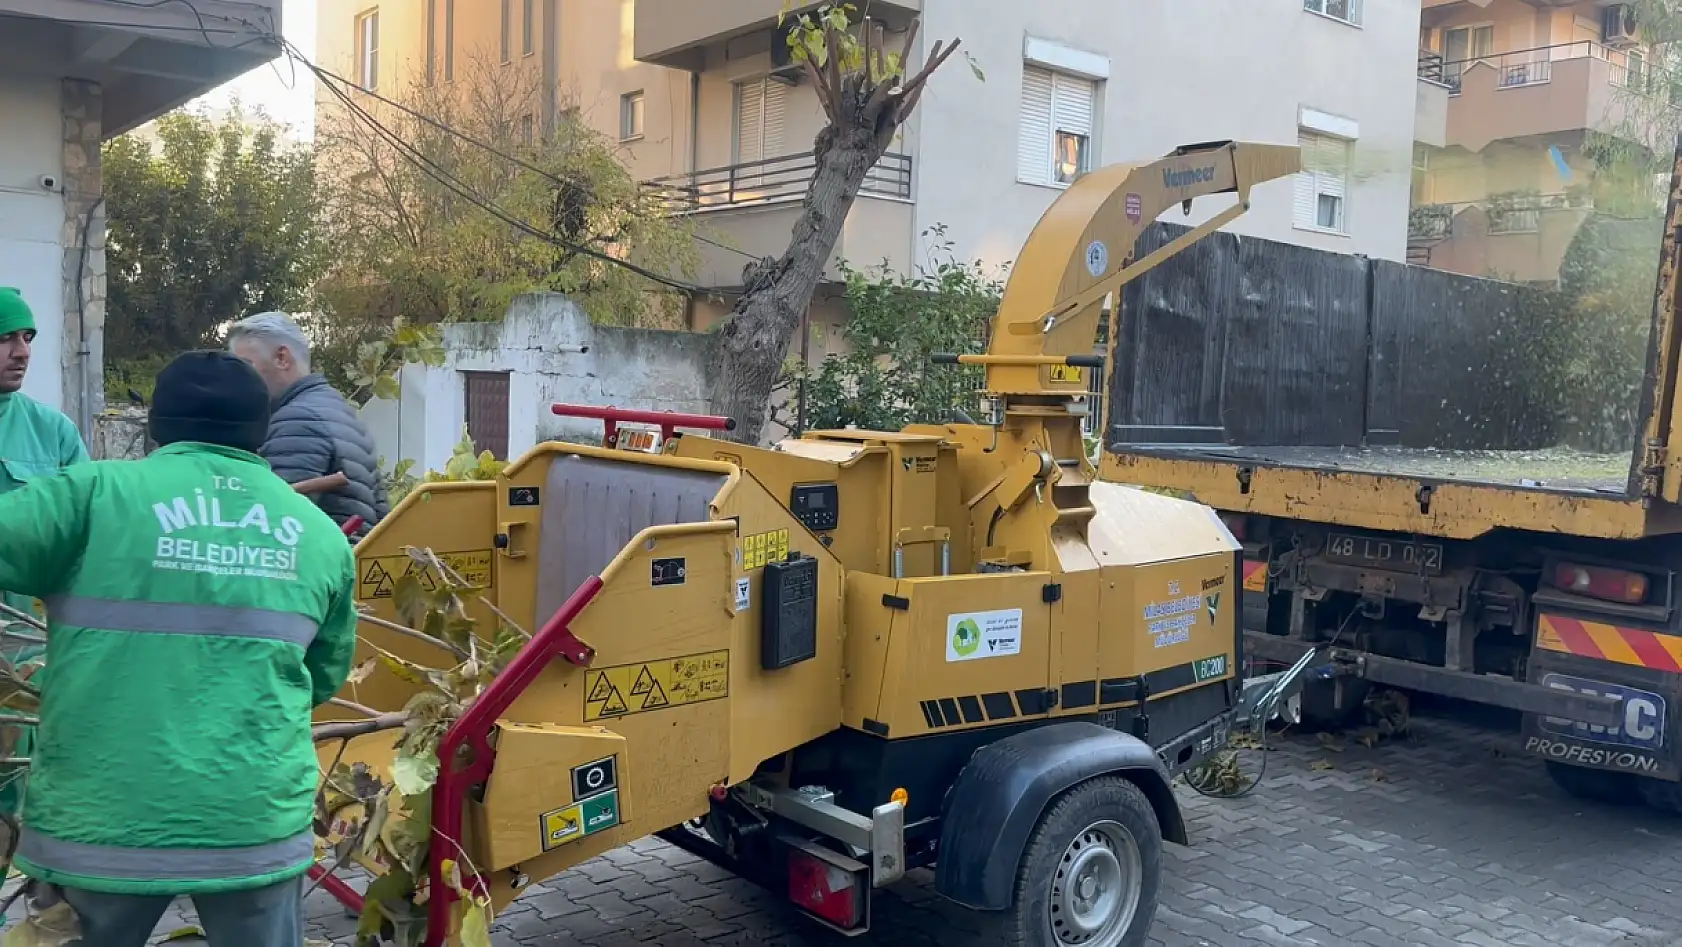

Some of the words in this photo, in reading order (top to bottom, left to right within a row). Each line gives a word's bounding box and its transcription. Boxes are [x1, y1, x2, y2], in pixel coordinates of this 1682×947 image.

[1162, 165, 1216, 188] Vermeer
[212, 475, 247, 492] T.C.
[152, 487, 304, 546] MİLAS
[157, 536, 297, 570] BELEDİYESİ
[1331, 537, 1354, 556] 48
[1364, 540, 1392, 560] LD
